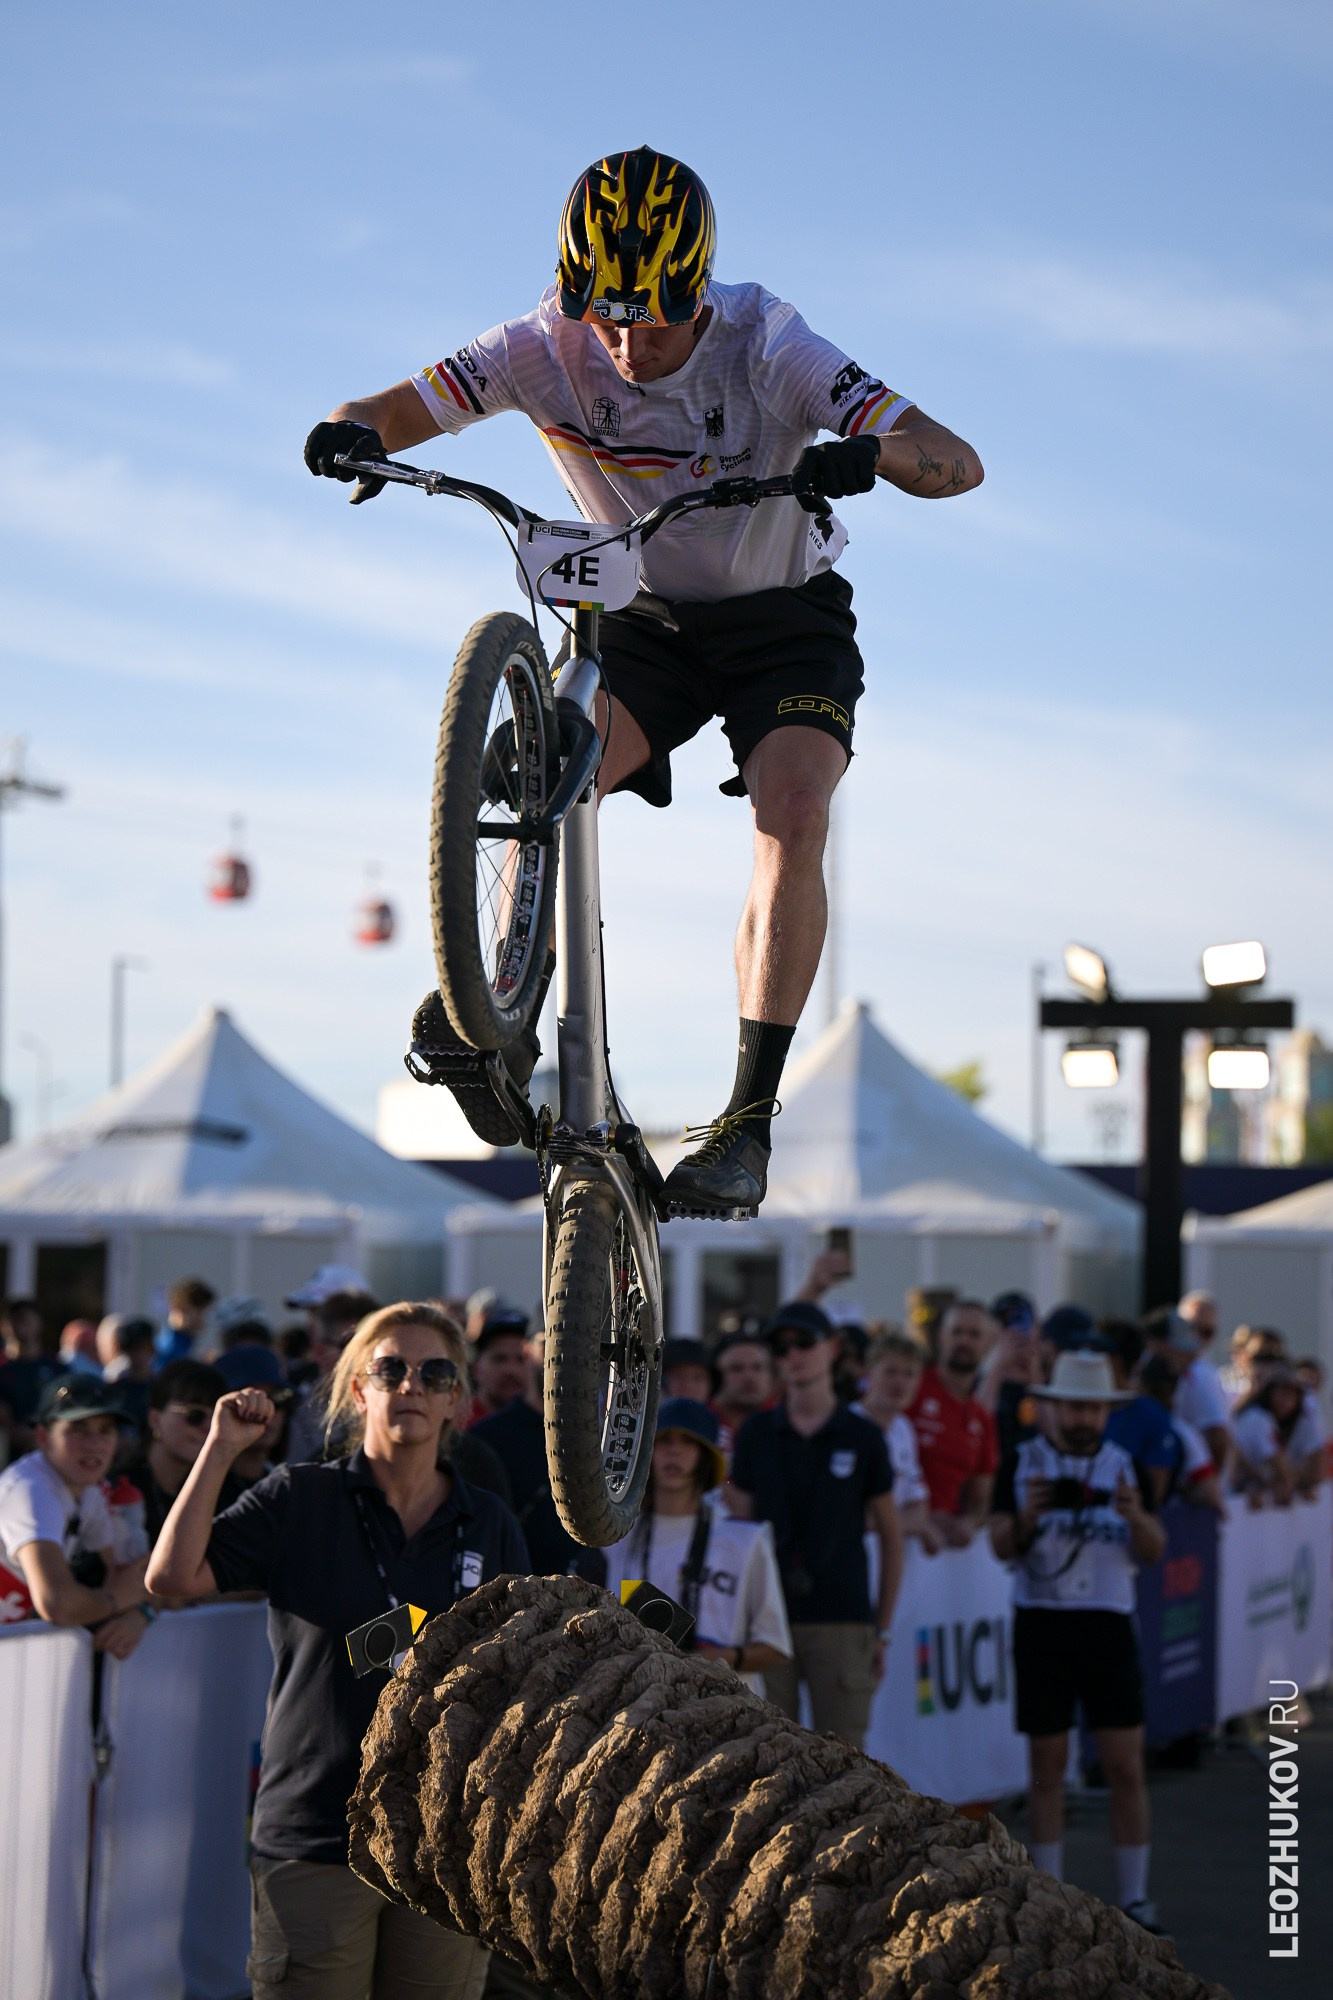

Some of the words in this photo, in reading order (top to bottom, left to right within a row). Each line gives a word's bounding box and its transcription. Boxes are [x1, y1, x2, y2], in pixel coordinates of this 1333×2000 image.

[456, 348, 488, 392] ODA
[535, 526, 551, 534] UCI
[551, 553, 600, 586] 4E
[935, 1617, 1007, 1712] UCI
